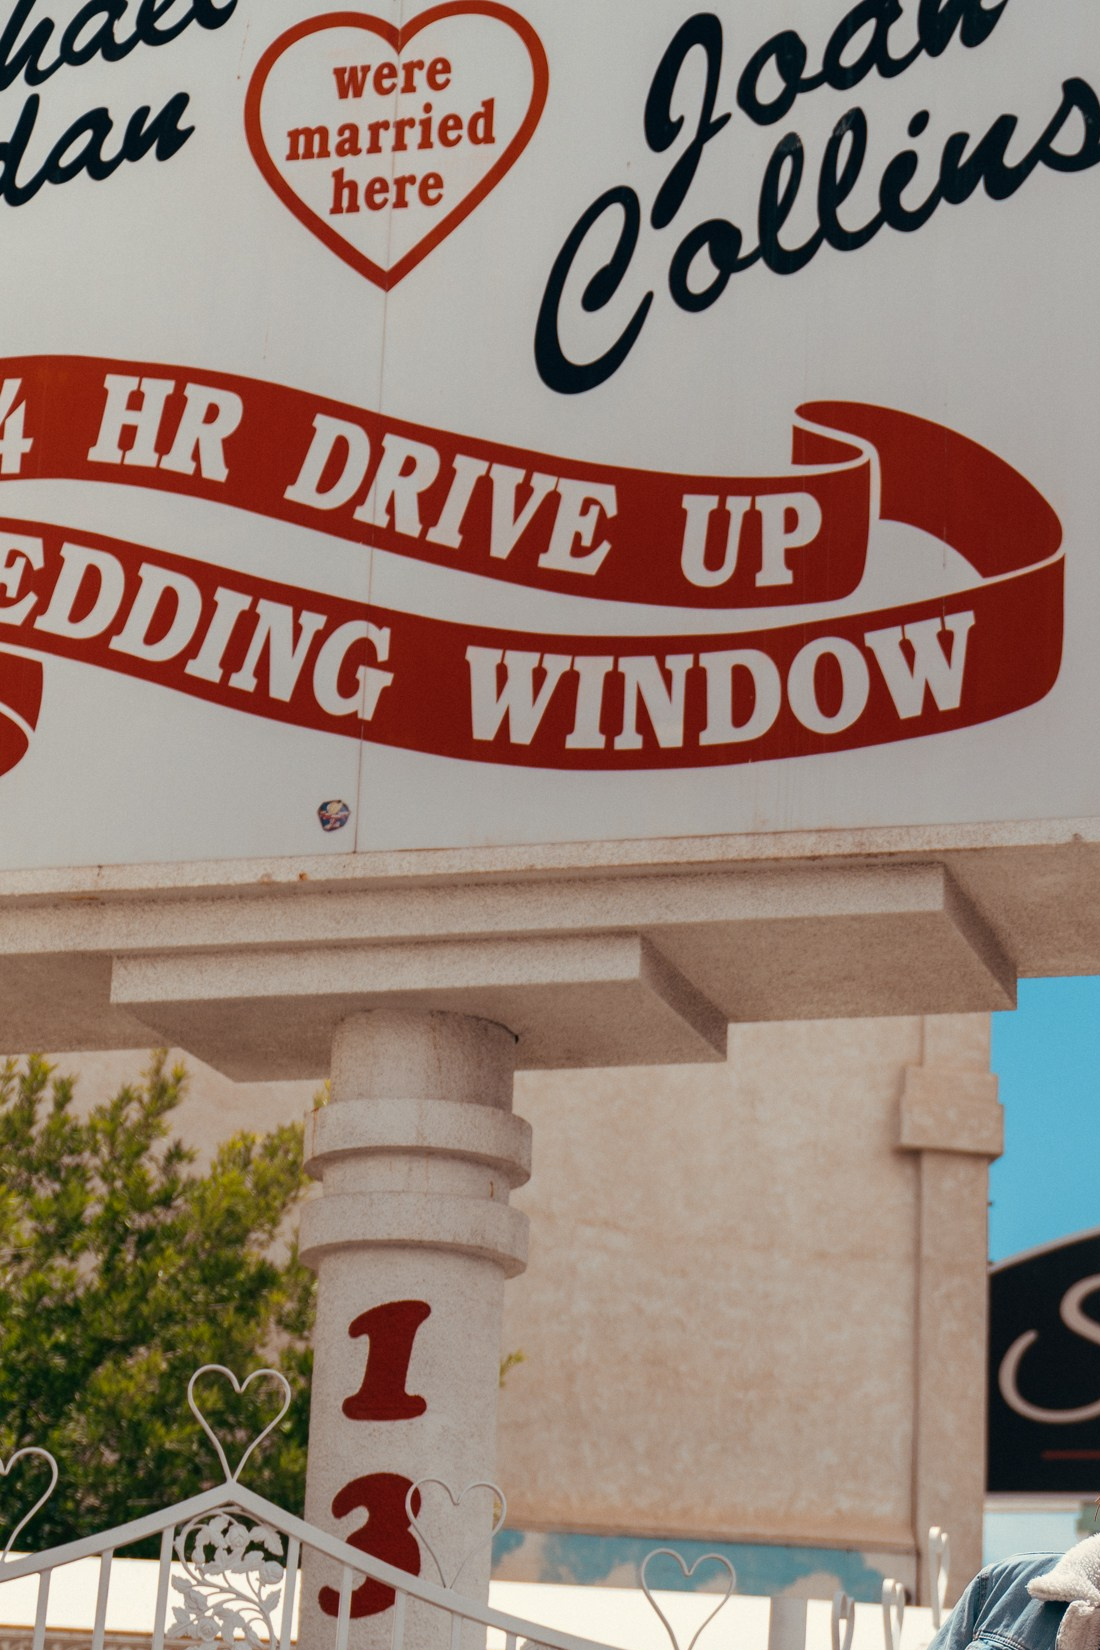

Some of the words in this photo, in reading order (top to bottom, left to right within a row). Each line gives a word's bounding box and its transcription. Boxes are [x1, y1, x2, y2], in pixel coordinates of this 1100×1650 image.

[285, 98, 496, 161] married
[333, 57, 453, 101] were
[644, 0, 1006, 230] Joan
[329, 168, 445, 215] here
[87, 373, 244, 483] HR
[283, 412, 618, 576] DRIVE
[681, 491, 823, 588] UP
[465, 609, 976, 751] WINDOW
